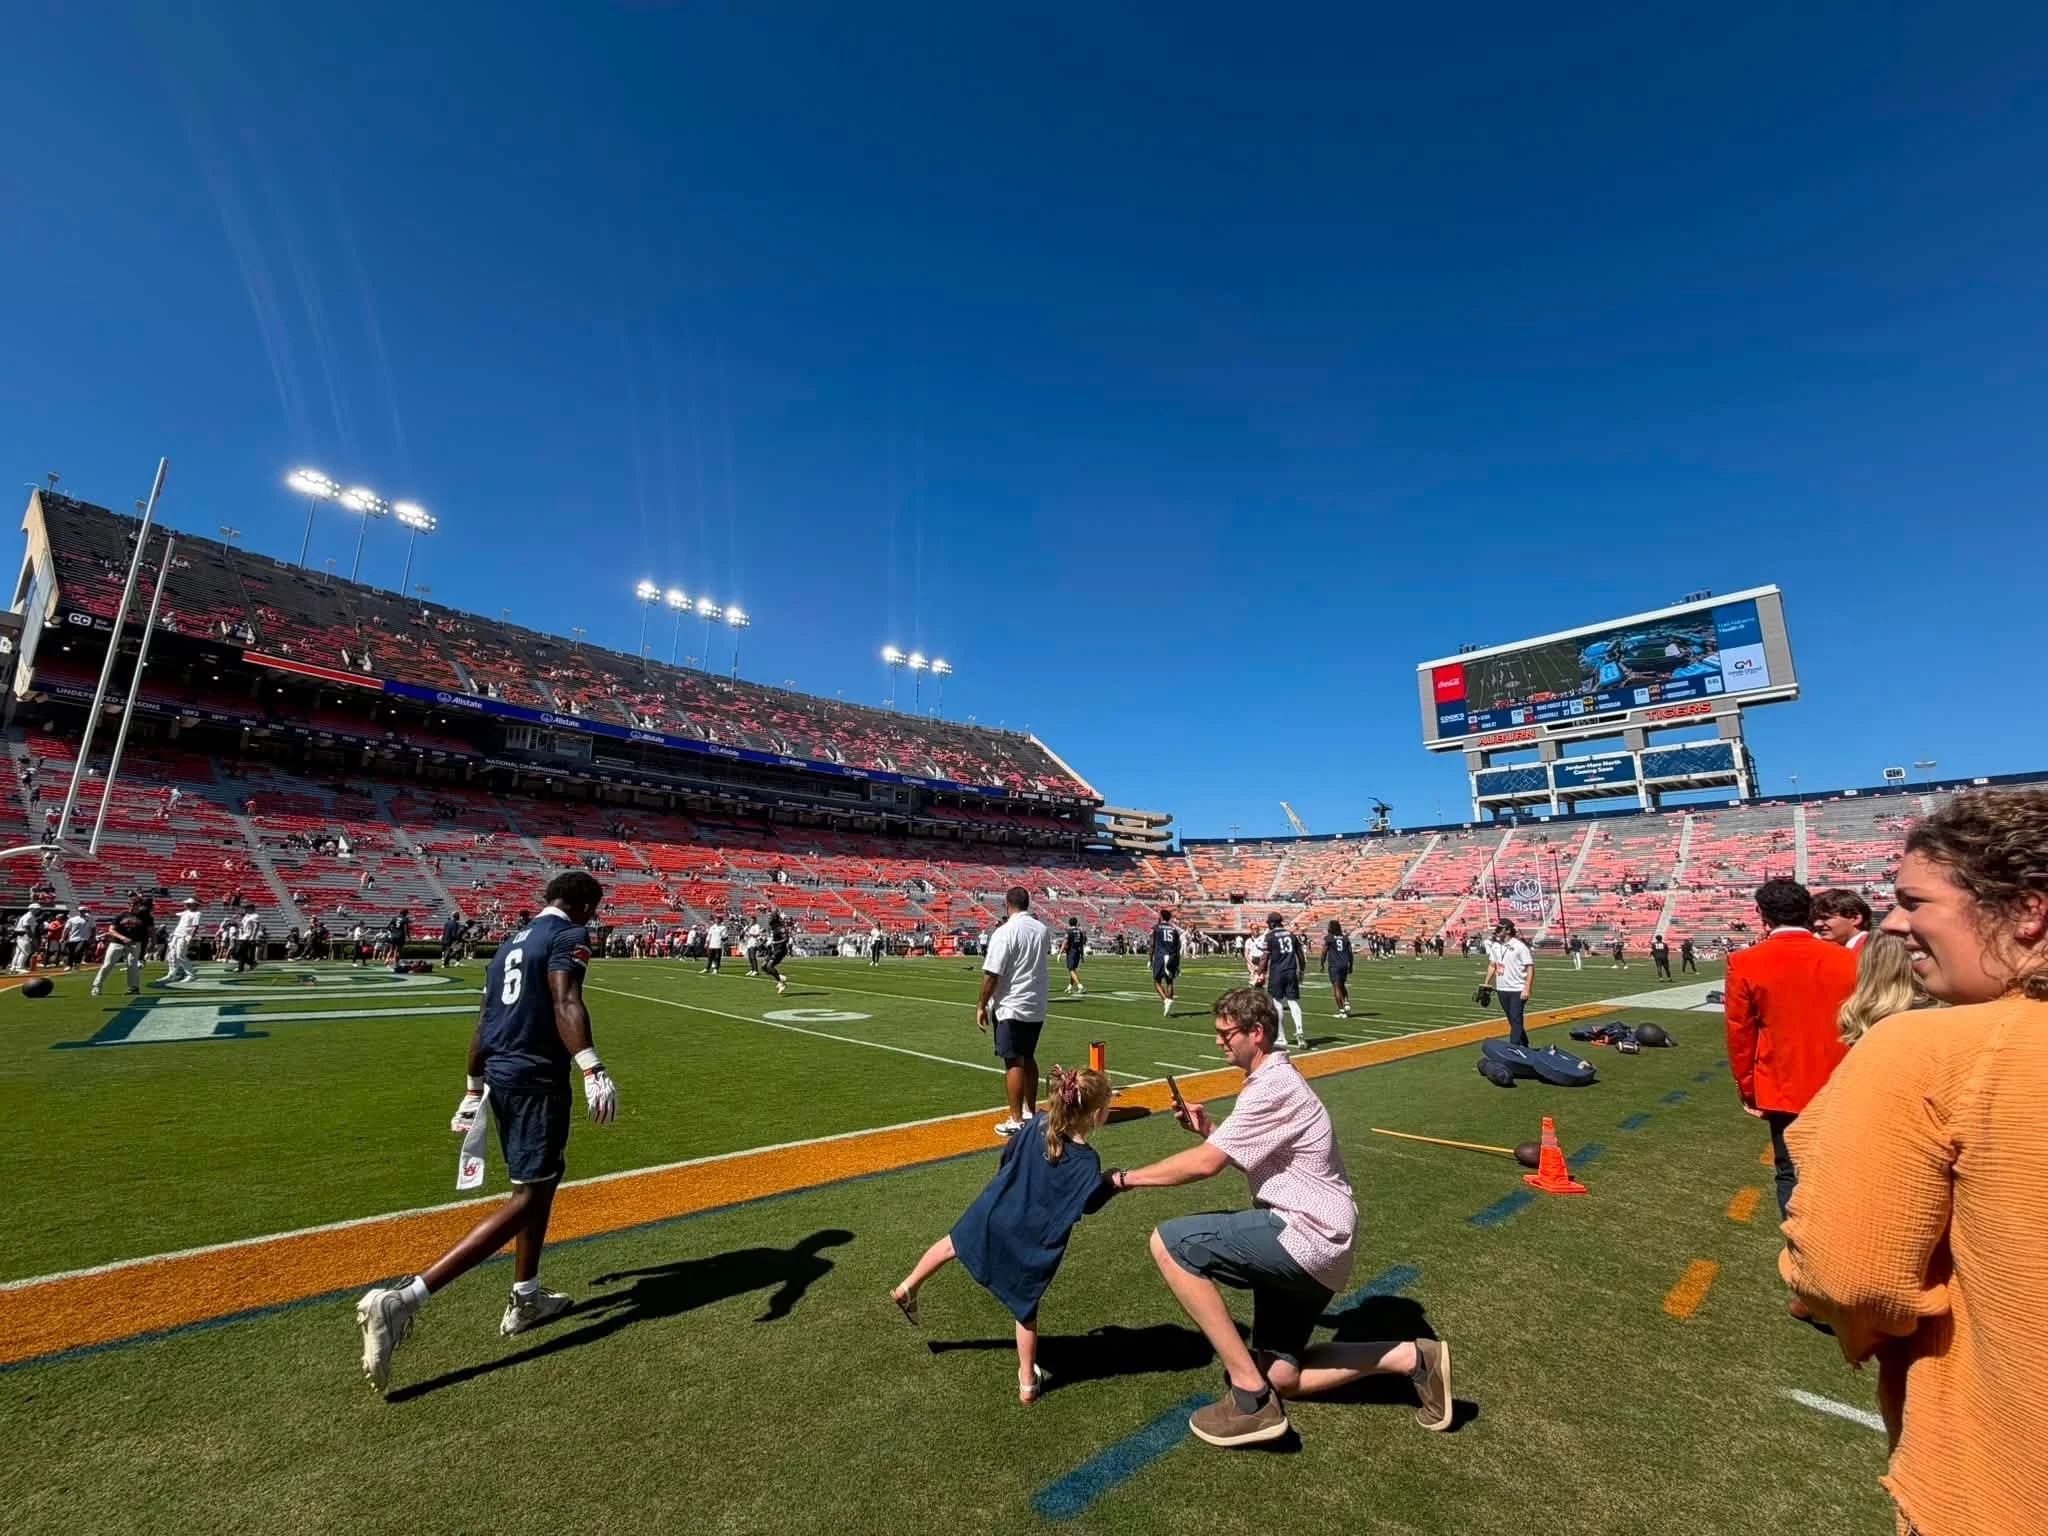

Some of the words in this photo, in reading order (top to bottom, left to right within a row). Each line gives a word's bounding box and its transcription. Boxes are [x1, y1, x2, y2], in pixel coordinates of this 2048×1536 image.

[451, 696, 483, 710] Allstate
[1646, 701, 1712, 720] TIGERS
[552, 716, 580, 728] Allstate
[1478, 729, 1536, 747] AUBURN
[1163, 930, 1173, 941] 15
[1278, 936, 1293, 953] 13
[1336, 939, 1343, 951] 9
[502, 948, 523, 1005] 6
